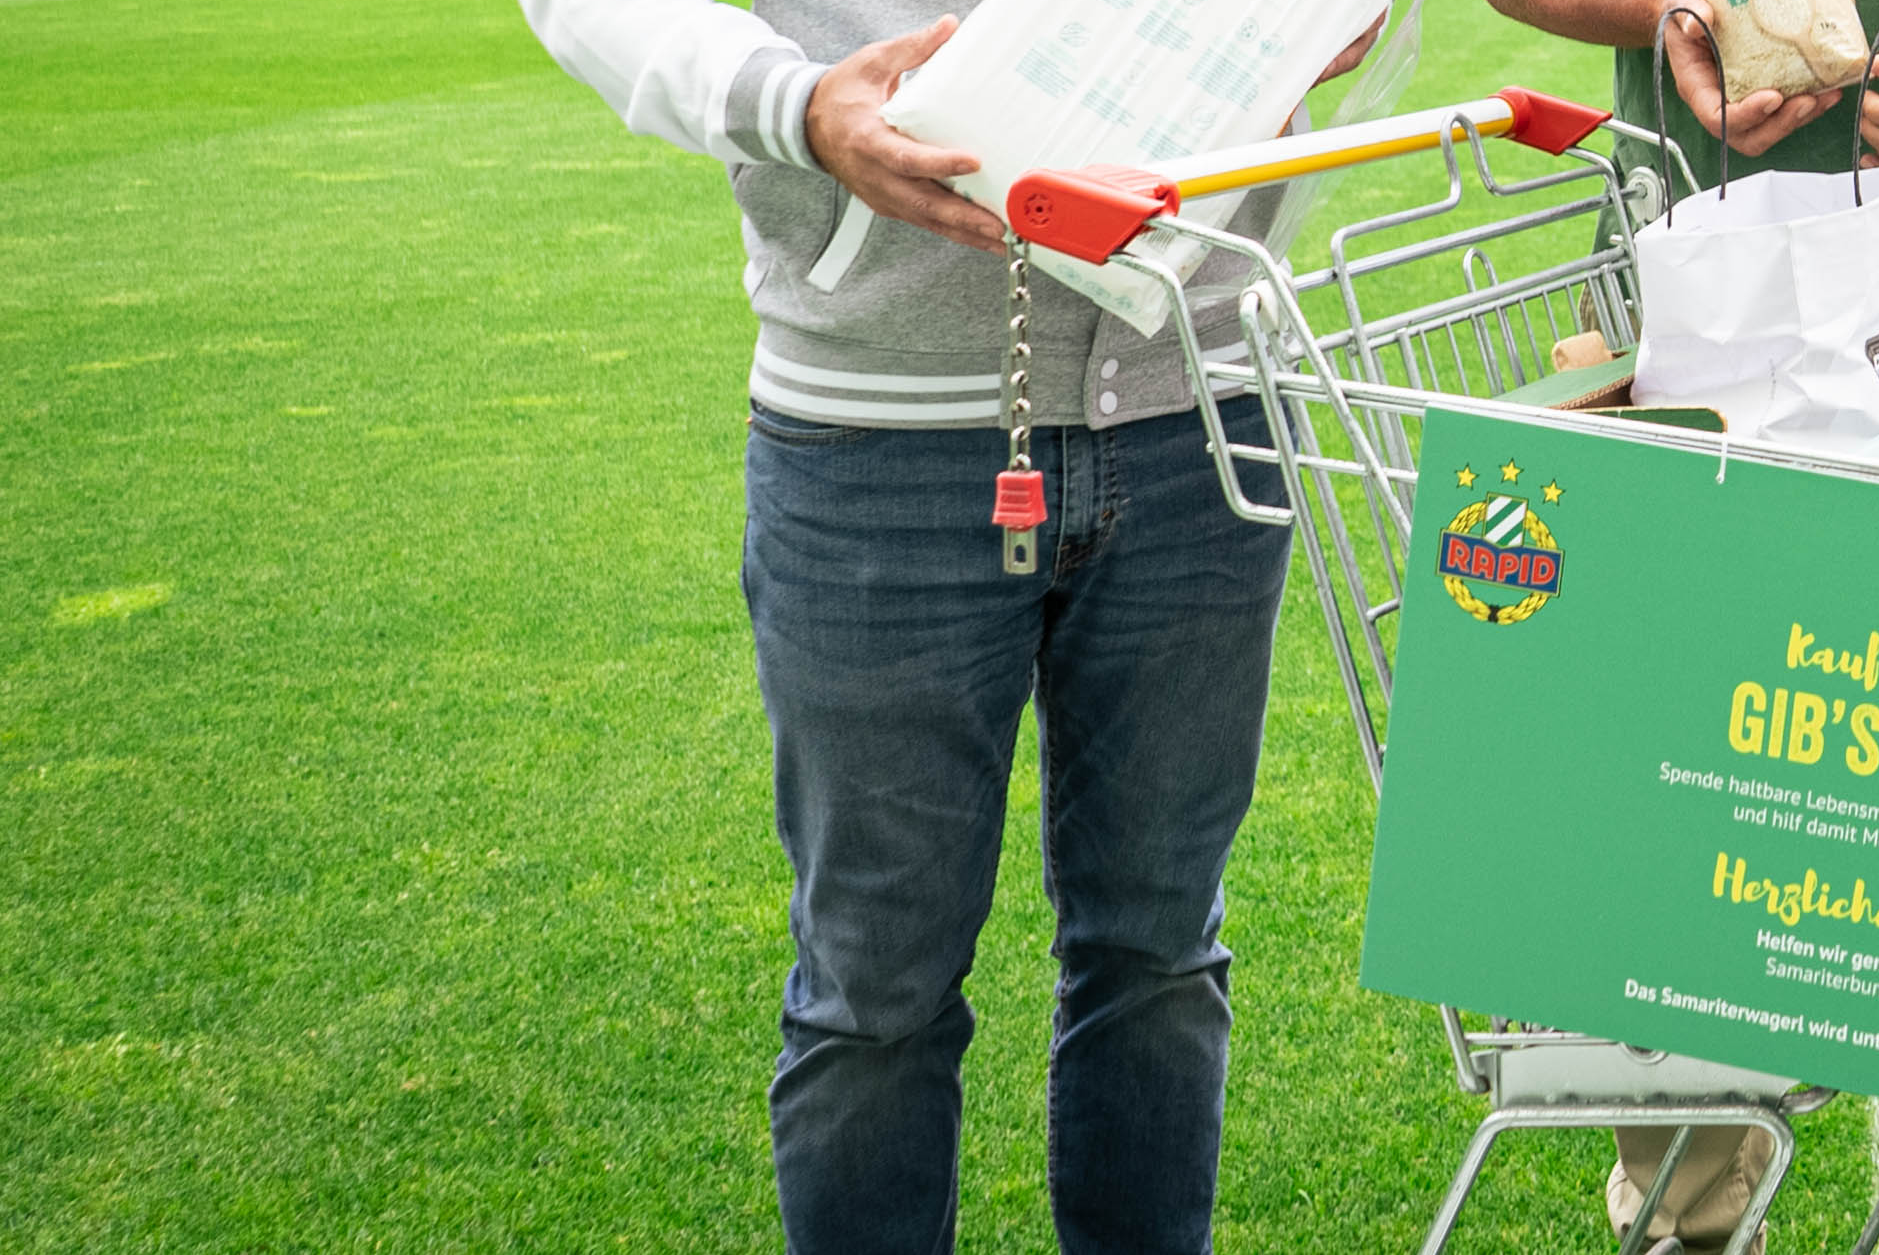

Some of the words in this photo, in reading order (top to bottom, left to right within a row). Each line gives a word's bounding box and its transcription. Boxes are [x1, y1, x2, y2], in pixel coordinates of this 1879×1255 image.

[1447, 537, 1556, 585] RAPID
[1659, 762, 1724, 792] Spende
[1729, 777, 1801, 807] haltbare
[1734, 803, 1766, 825] und
[1772, 811, 1803, 832] hilf
[1807, 817, 1857, 844] damit
[1757, 929, 1815, 958] Helfen
[1819, 942, 1848, 964] wir
[1625, 978, 1657, 1003] Das
[1661, 986, 1804, 1035] Samariterwagerl
[1809, 1020, 1848, 1043] wird
